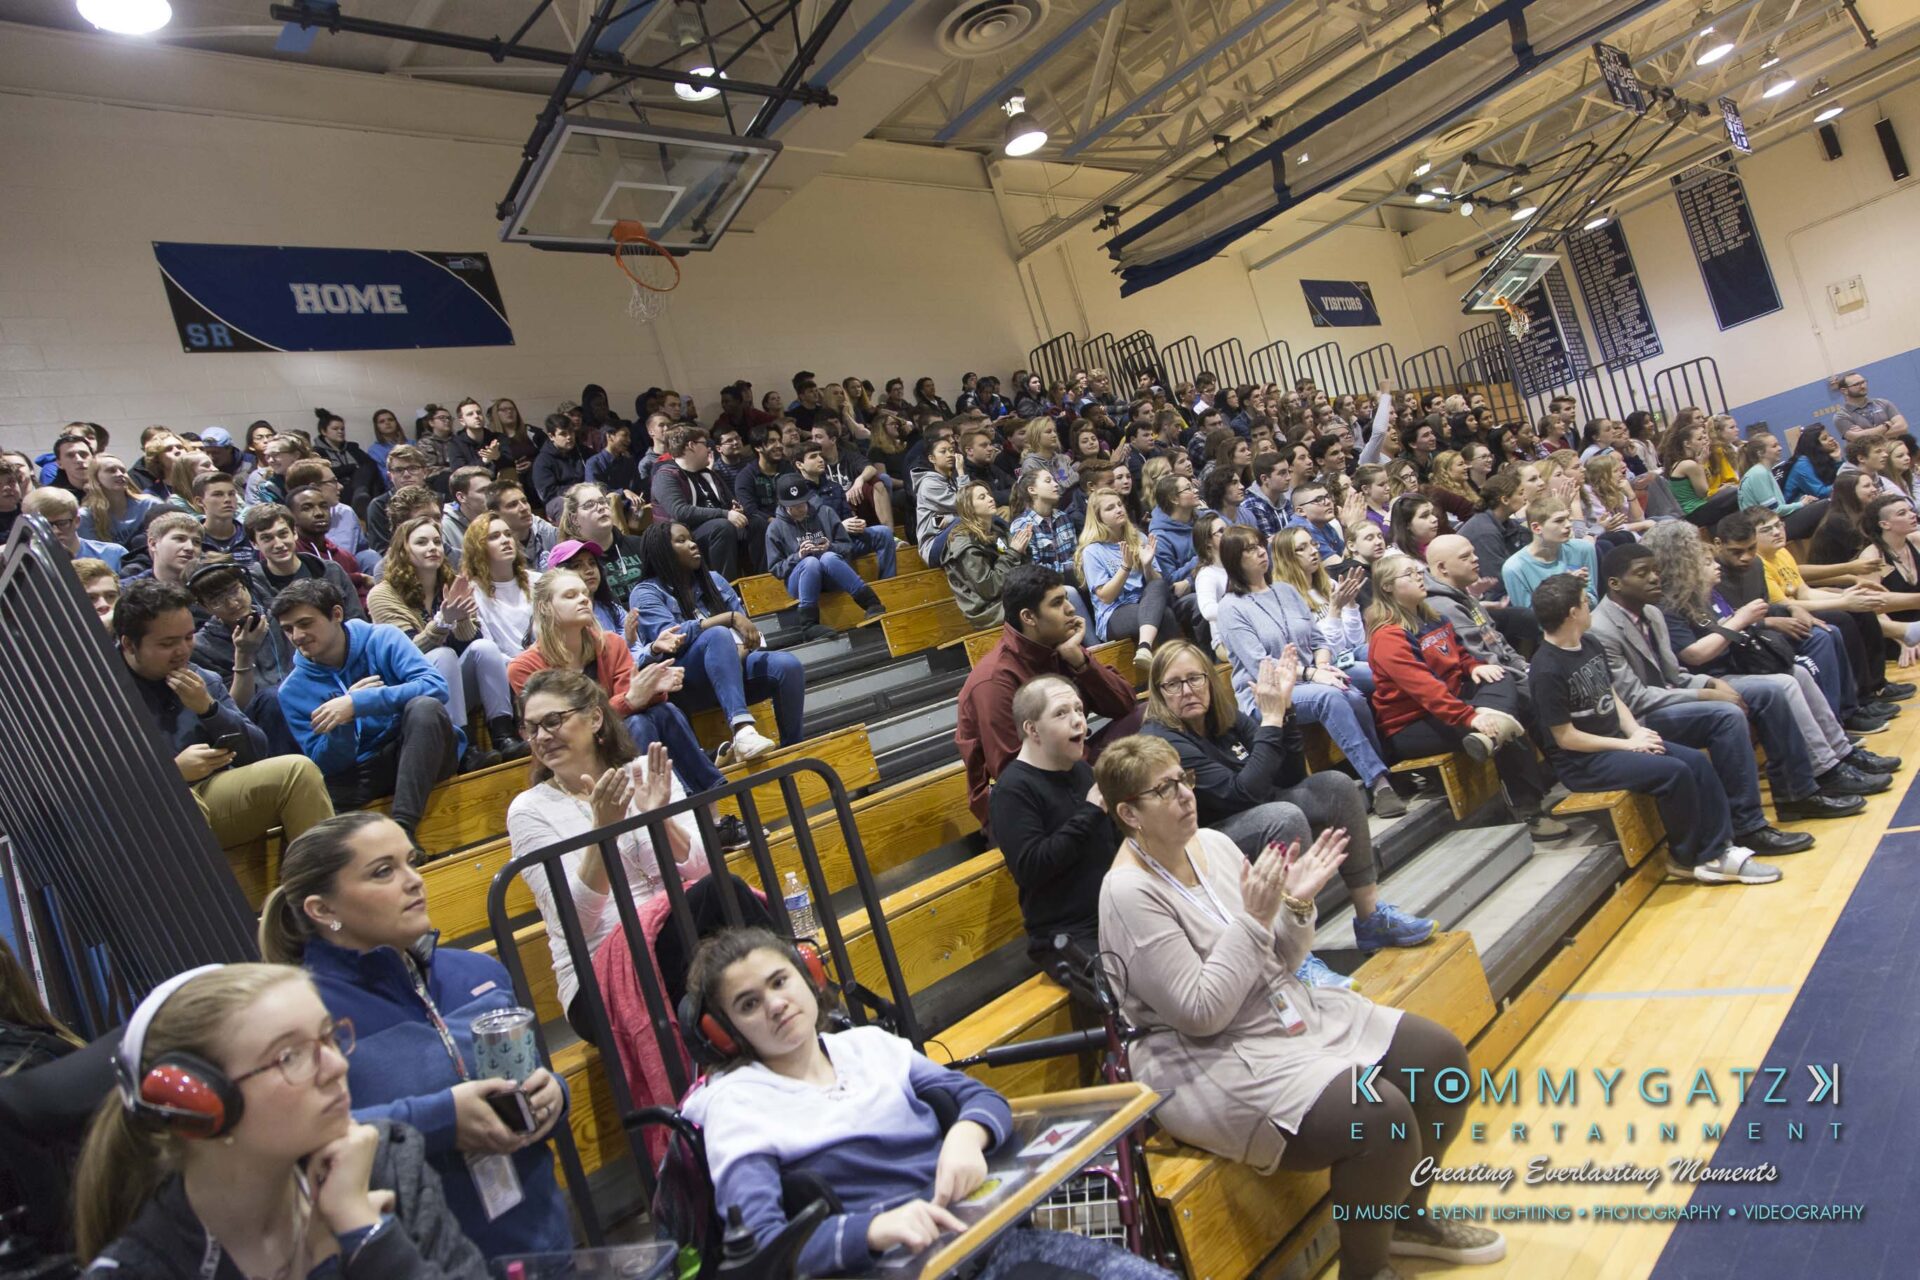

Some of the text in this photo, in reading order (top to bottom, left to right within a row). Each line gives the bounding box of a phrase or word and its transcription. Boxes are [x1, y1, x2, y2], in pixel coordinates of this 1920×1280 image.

[289, 283, 408, 314] HOME
[1320, 296, 1363, 311] VISITORS
[186, 323, 234, 347] SR
[1596, 694, 1615, 715] G
